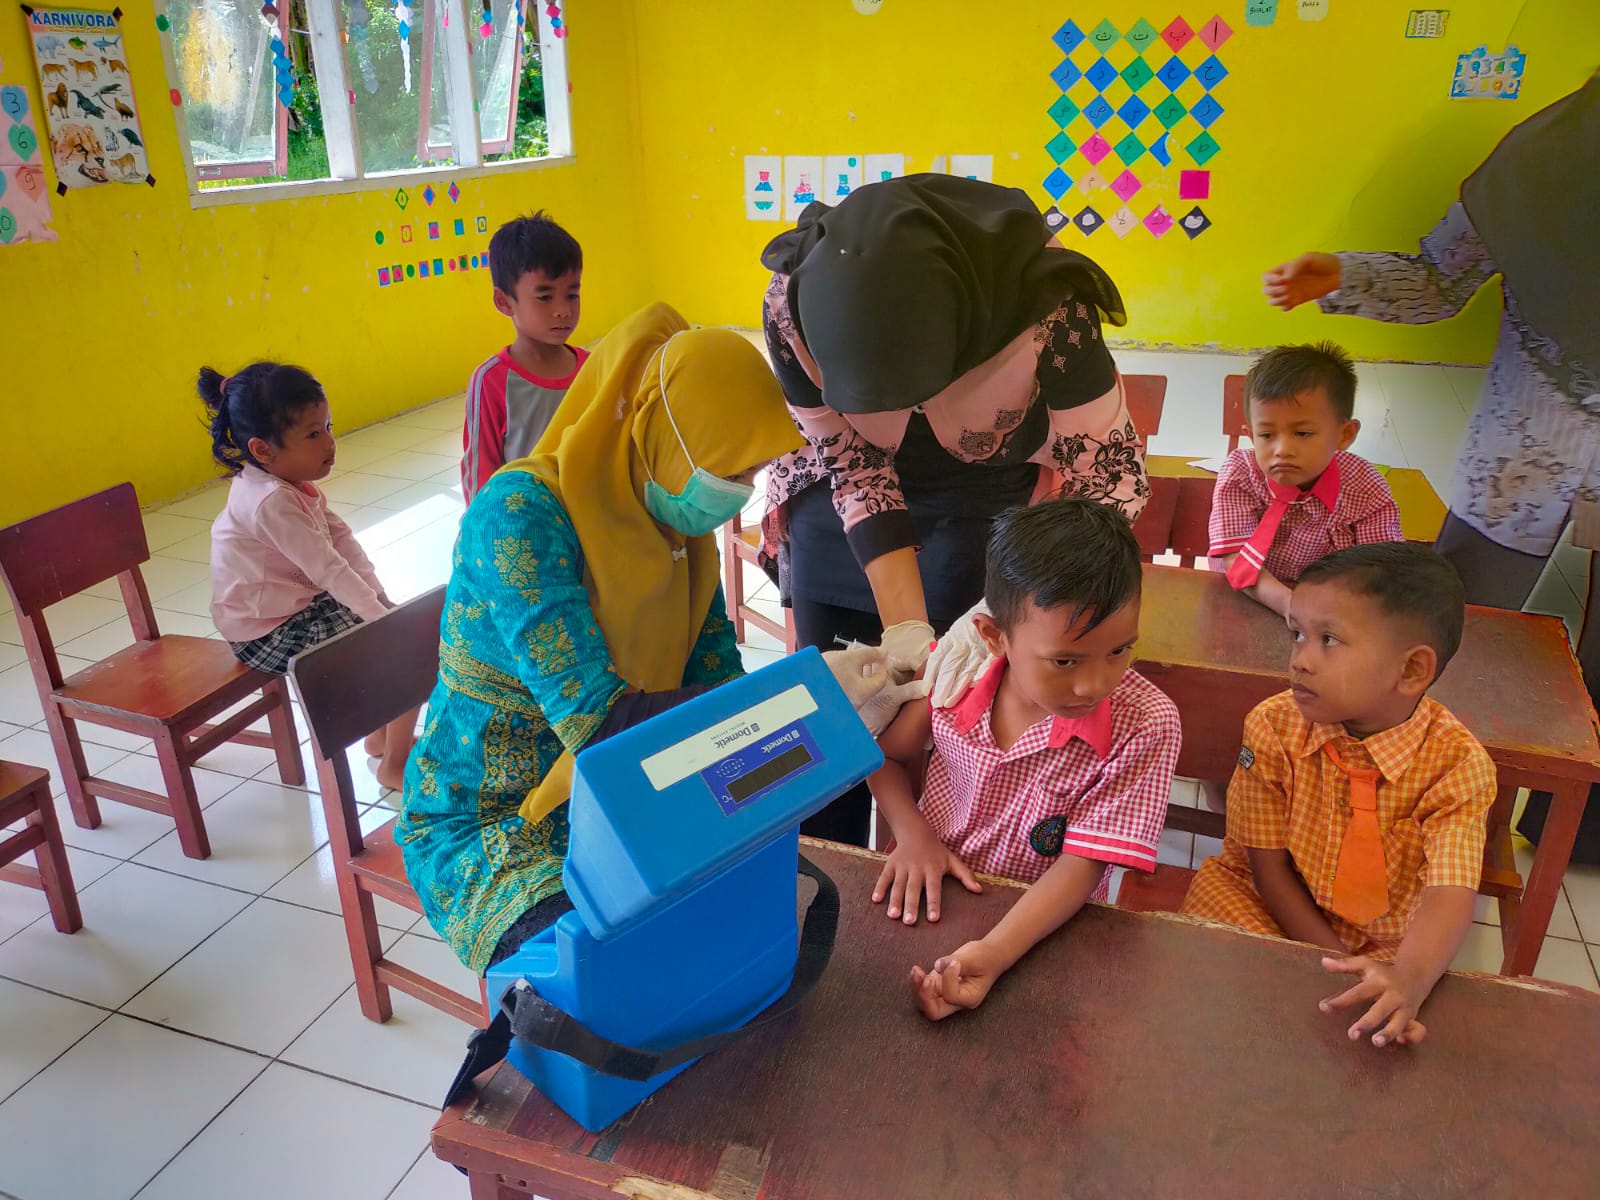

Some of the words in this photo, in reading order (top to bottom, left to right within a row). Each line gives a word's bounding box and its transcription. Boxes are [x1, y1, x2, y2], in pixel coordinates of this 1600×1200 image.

[32, 12, 116, 28] KARNIVORA
[7, 92, 20, 114] 3
[17, 131, 28, 149] 6
[24, 173, 36, 190] 9
[713, 722, 752, 749] Dometic
[760, 733, 794, 753] Dometic
